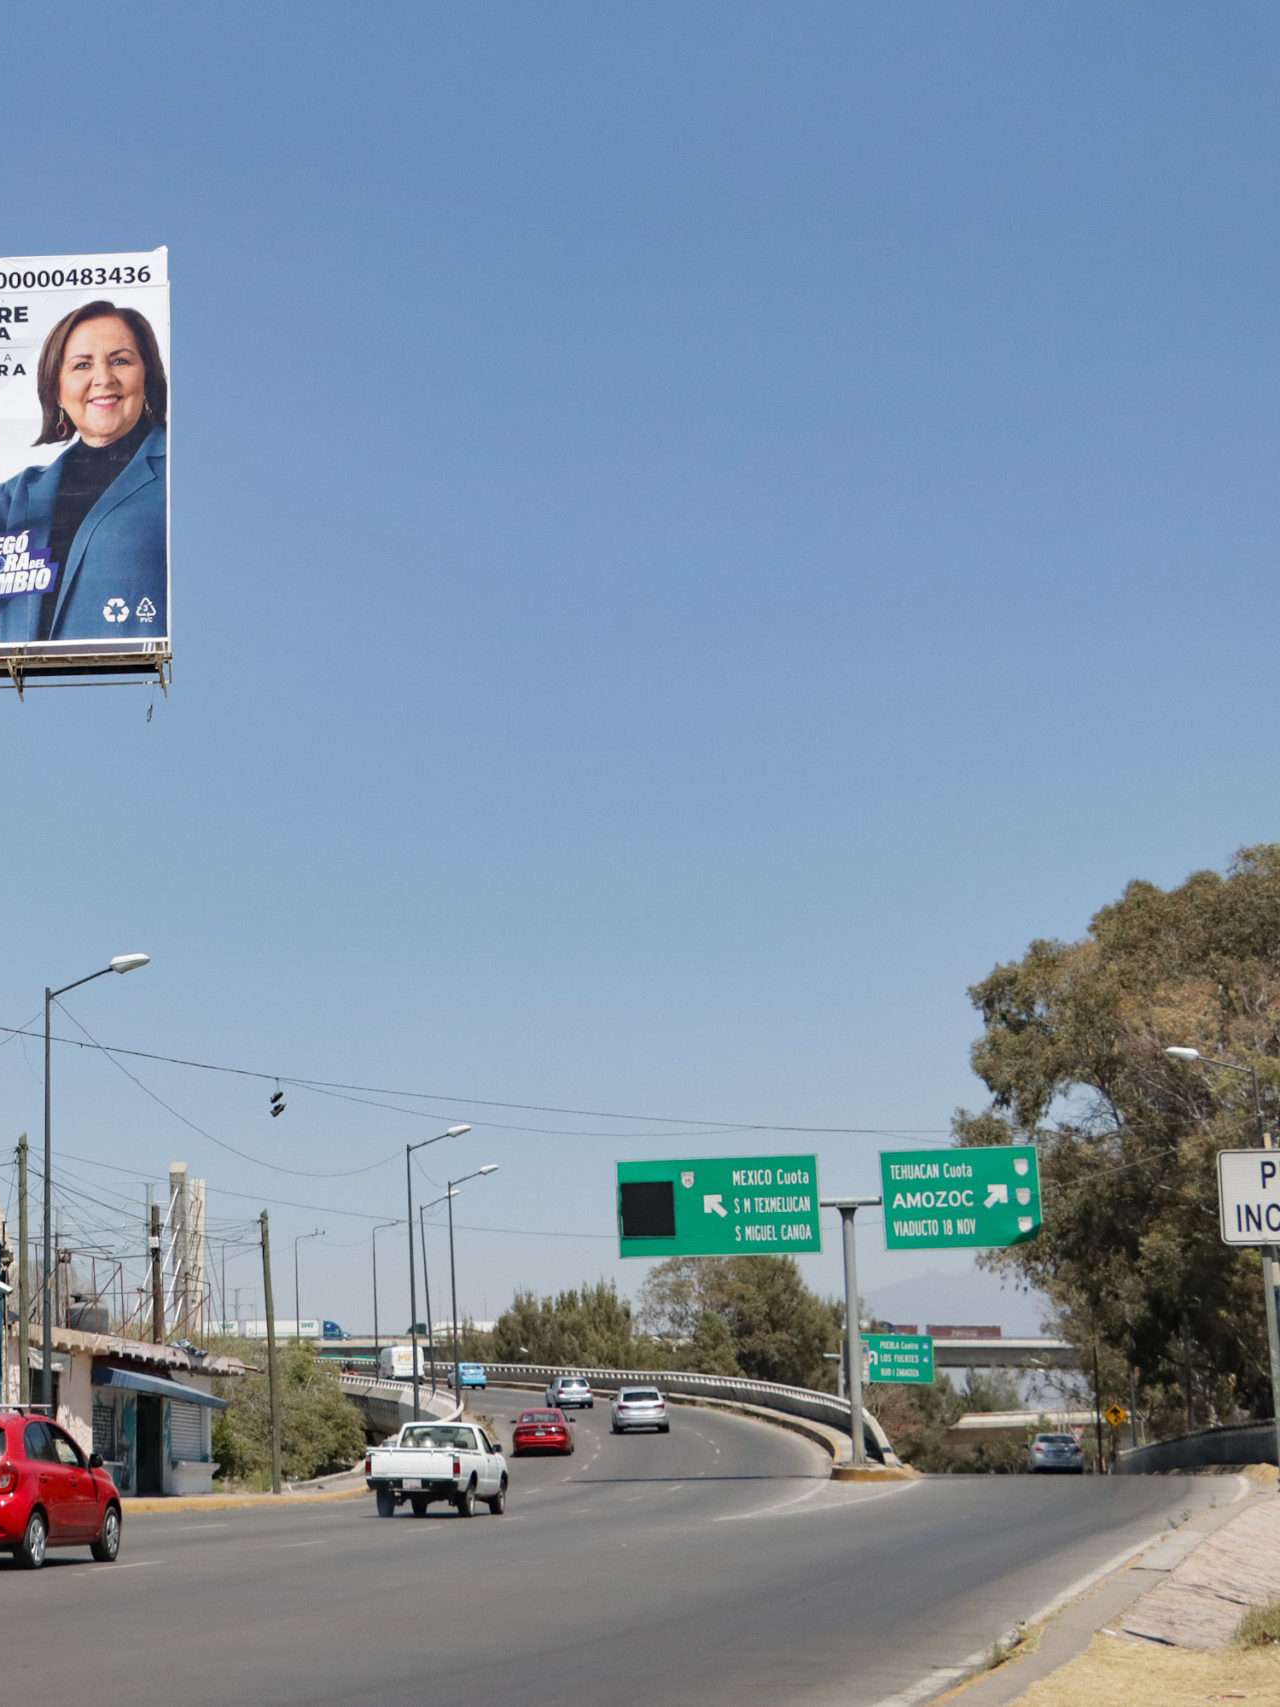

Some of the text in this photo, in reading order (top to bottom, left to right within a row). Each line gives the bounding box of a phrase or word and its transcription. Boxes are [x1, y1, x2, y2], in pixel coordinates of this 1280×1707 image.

[29, 558, 46, 569] DEL
[732, 1168, 810, 1186] MEXICO Cuota
[890, 1162, 973, 1180] TEHUACAN Cuota
[734, 1198, 740, 1215] S
[754, 1196, 811, 1213] TEXMELUCAN
[892, 1190, 974, 1209] AMOZOC
[735, 1223, 813, 1242] S MIGUEL CANOA
[893, 1218, 976, 1236] VIADUCTO 18 NOV
